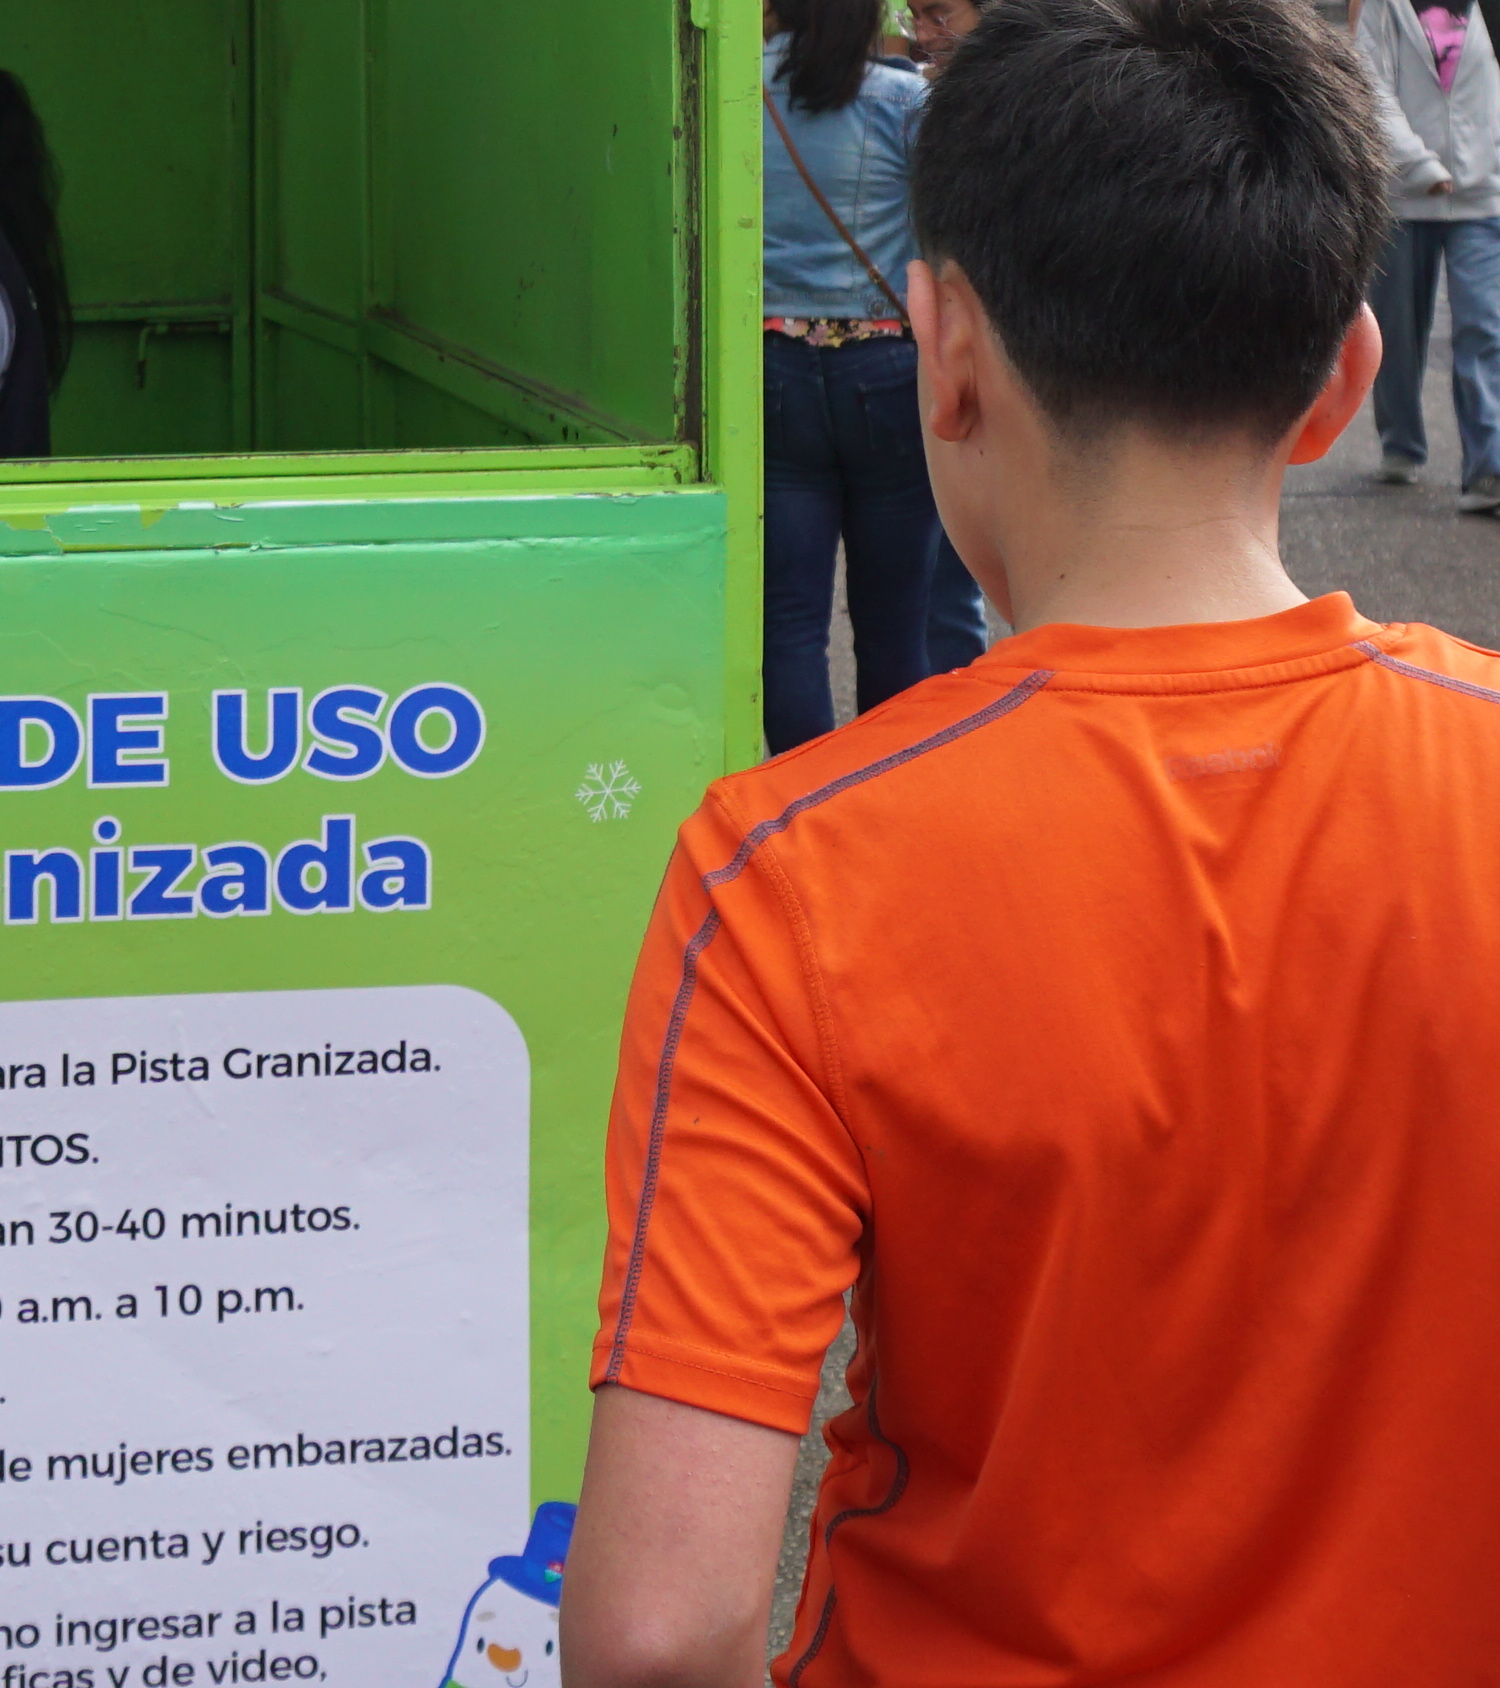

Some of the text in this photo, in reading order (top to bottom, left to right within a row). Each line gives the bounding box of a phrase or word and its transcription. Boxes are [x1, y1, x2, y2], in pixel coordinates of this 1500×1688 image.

[211, 682, 487, 782] USO
[61, 1052, 97, 1088] la
[111, 1049, 210, 1086] Pista
[222, 1038, 443, 1081] Granizada.
[48, 1206, 167, 1245] 30-40
[181, 1201, 361, 1240] minutos.
[16, 1295, 103, 1325] a.m.
[114, 1292, 139, 1320] a
[153, 1283, 203, 1318] 10
[216, 1285, 305, 1325] p.m.
[46, 1441, 215, 1487] mujeres
[226, 1424, 514, 1471] embarazadas.
[44, 1529, 190, 1567] cuenta
[200, 1530, 226, 1567] y
[238, 1519, 370, 1560] riesgo.
[55, 1611, 223, 1654] ingresar
[233, 1609, 257, 1636] a
[271, 1598, 306, 1634] la
[319, 1594, 417, 1640] pista
[142, 1654, 196, 1688] de
[206, 1648, 328, 1682] video,
